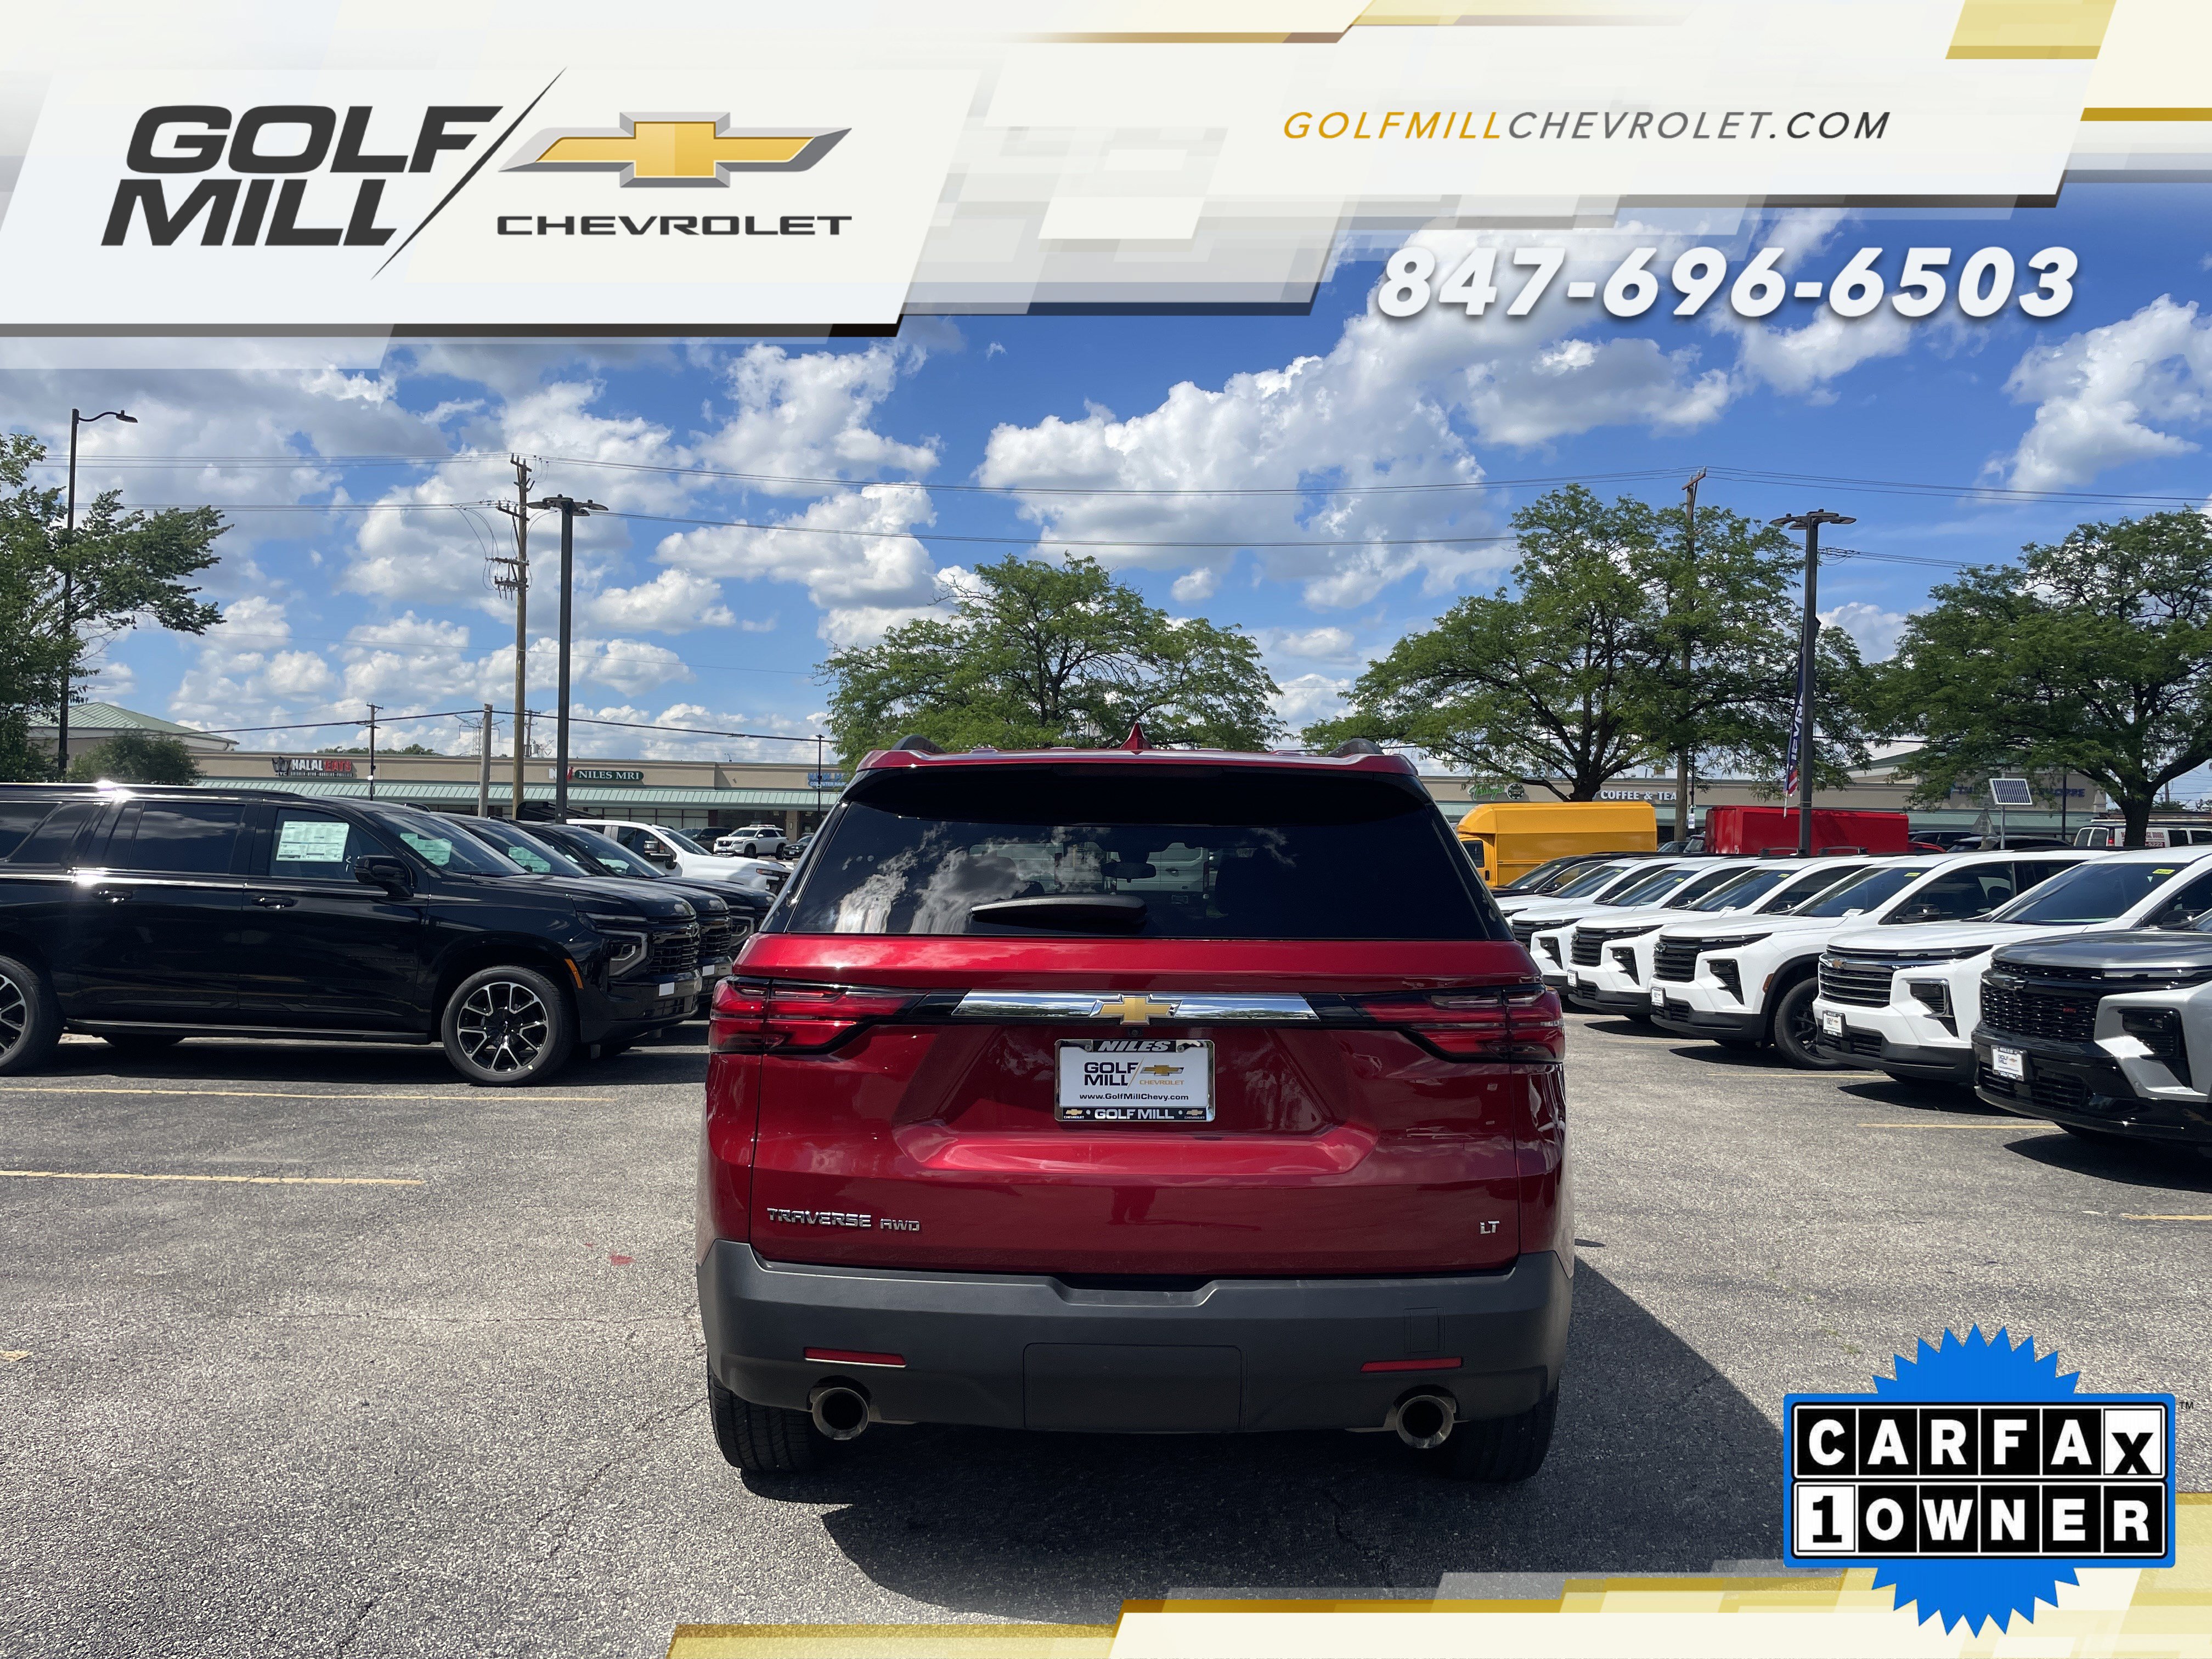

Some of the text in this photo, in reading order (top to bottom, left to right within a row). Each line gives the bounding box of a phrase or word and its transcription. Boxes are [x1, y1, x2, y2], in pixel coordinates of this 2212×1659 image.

[292, 759, 352, 771] HALAL EATS
[579, 771, 612, 779] NILES
[1600, 790, 1677, 800] COFFEE & TEA
[1098, 1041, 1171, 1051] NILES
[1084, 1062, 1139, 1074] GOLF
[1084, 1074, 1128, 1086] MILL
[1094, 1109, 1175, 1119] GOLF MILL
[767, 1207, 920, 1231] TRAVERSE AWD
[1480, 1221, 1500, 1234] LT
